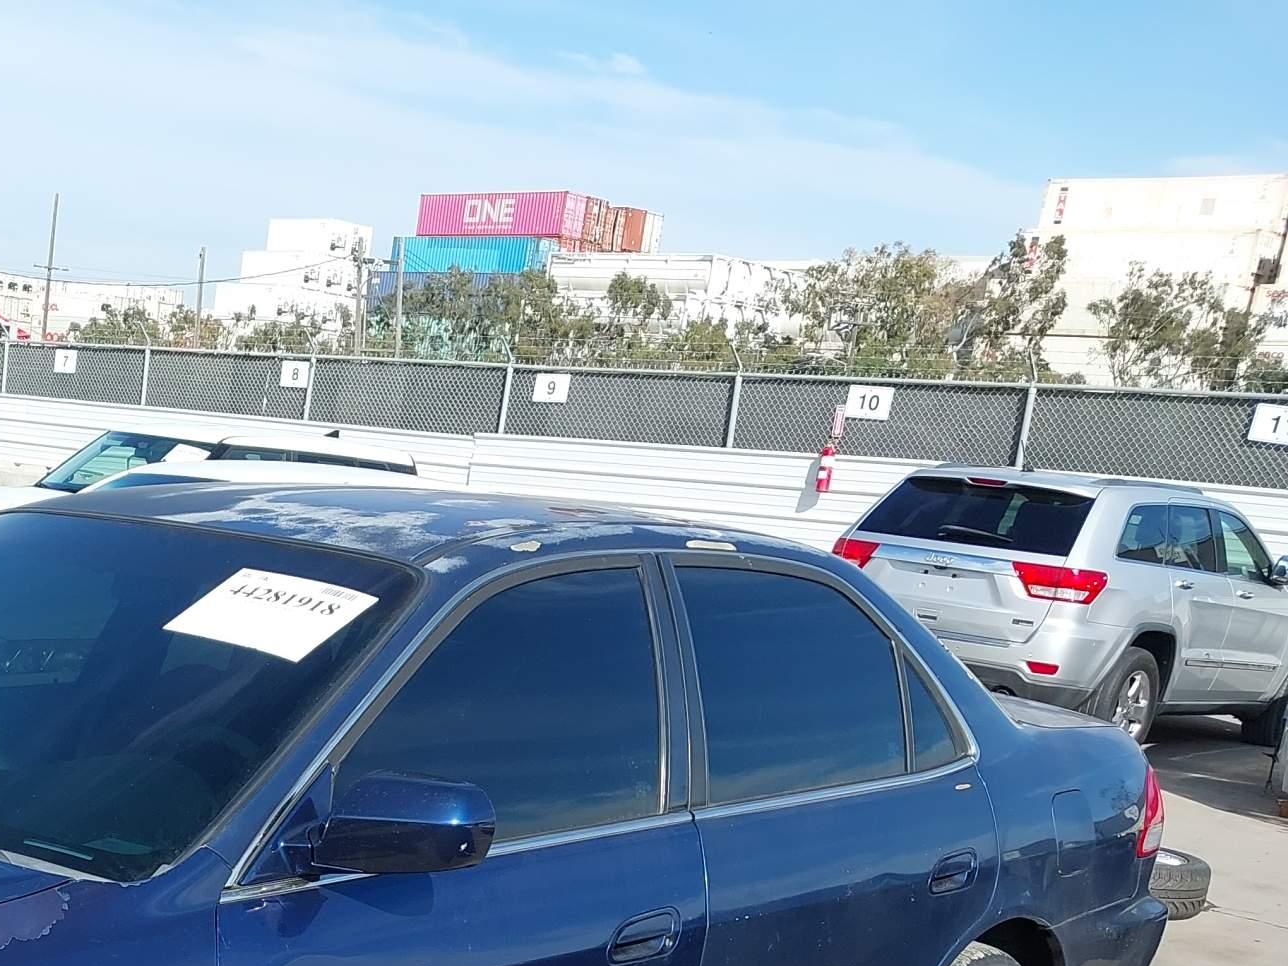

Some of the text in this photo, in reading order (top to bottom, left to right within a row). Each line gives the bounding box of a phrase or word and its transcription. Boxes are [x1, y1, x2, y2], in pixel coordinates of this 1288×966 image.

[463, 199, 515, 222] ONE
[63, 355, 69, 367] 7
[292, 367, 299, 380] 8
[547, 380, 556, 395] 9
[859, 393, 880, 411] 10
[230, 584, 341, 616] 44281918
